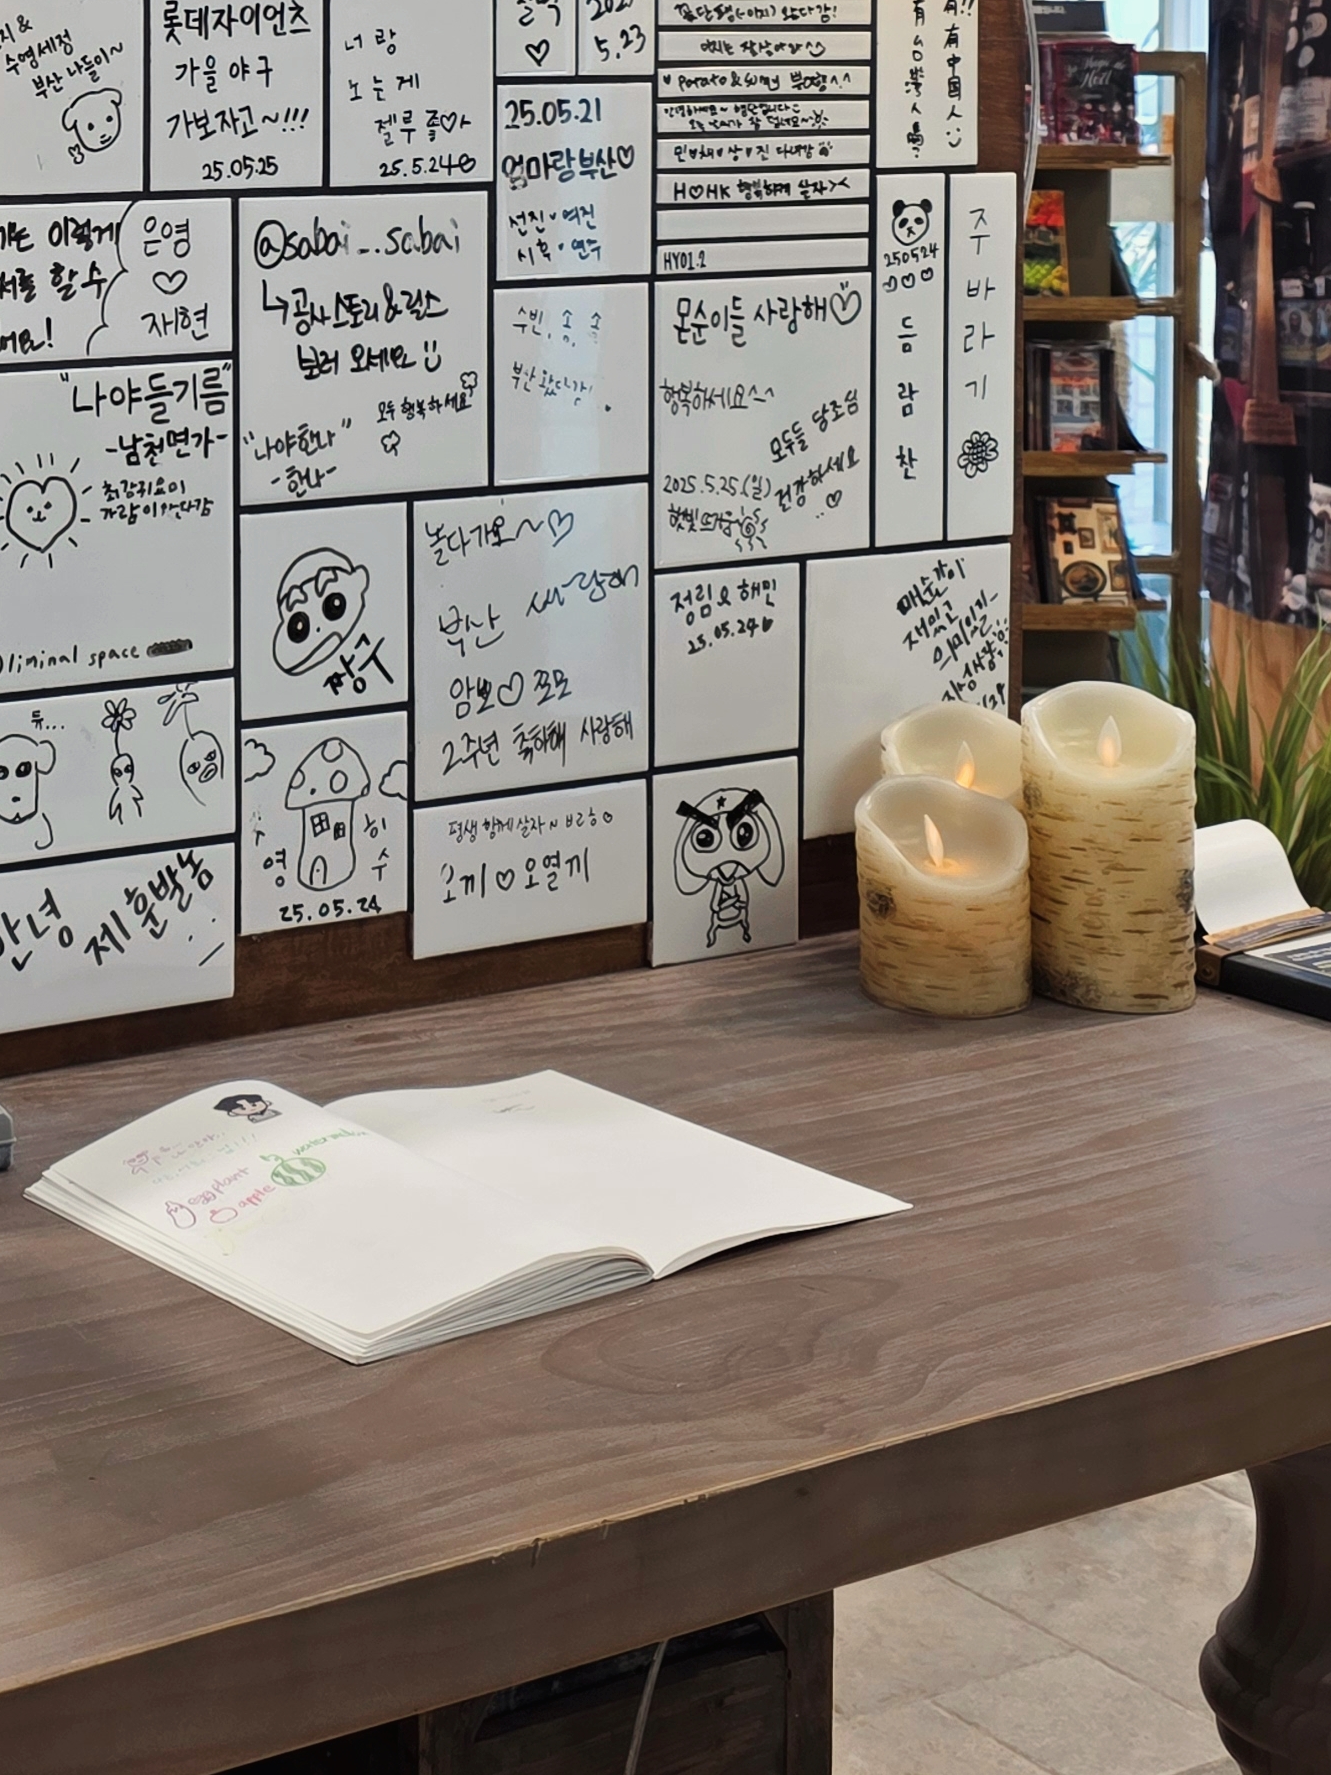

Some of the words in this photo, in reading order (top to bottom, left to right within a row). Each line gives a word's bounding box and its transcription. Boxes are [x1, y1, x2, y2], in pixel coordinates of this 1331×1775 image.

[344, 27, 398, 56] 너랑
[30, 71, 64, 100] 부산
[174, 54, 218, 95] 가을
[228, 54, 274, 89] 야구
[348, 75, 386, 102] 노는
[395, 72, 421, 91] 게
[504, 96, 603, 130] 25.05.21
[201, 153, 280, 182] 25.05.25
[578, 145, 619, 181] 부산
[143, 215, 192, 260] 은영
[883, 242, 941, 268] 250524
[49, 261, 79, 303] 할
[80, 260, 108, 301] 수
[753, 293, 828, 336] 사랑해
[400, 391, 474, 421] 행복하세요
[438, 603, 506, 658] 부산
[88, 644, 141, 670] space
[441, 729, 500, 777] 2주년
[579, 709, 634, 747] 사랑해
[237, 1182, 276, 1210] apple
